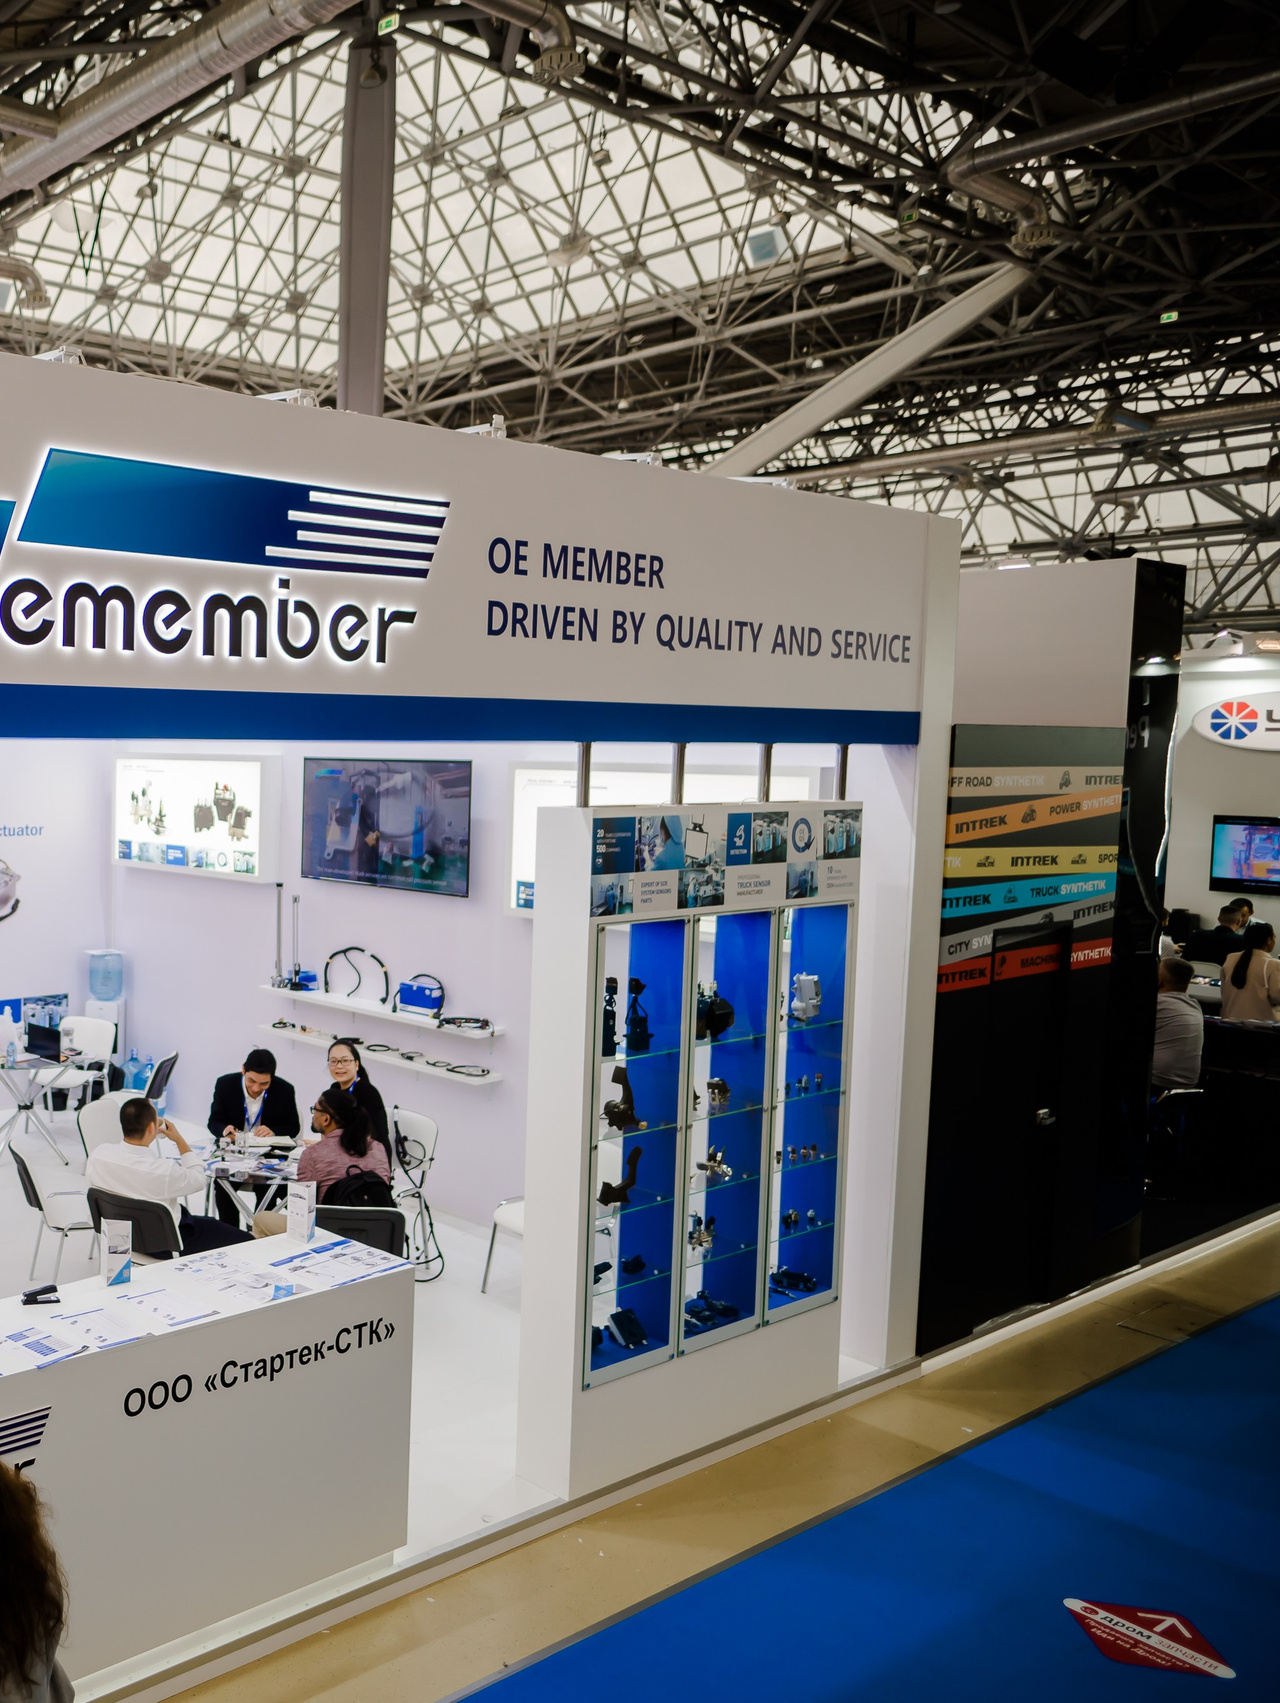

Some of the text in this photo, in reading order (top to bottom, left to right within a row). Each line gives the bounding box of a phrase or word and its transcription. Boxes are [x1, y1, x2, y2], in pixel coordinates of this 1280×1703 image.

[487, 536, 665, 590] OE MEMBER
[486, 600, 912, 664] DRIVEN BY QUALITY AND SERVICE
[965, 776, 993, 788] ROAD
[994, 775, 1045, 788] SYNTHETIK
[1049, 802, 1081, 817] POWER
[954, 814, 1009, 835] INTREK
[1010, 855, 1059, 868] INTREK
[1030, 879, 1106, 898] TRUCK SYNTHETIK
[947, 933, 993, 956] CITY SYN
[123, 1317, 396, 1417] ООО «Стартек-СТК»
